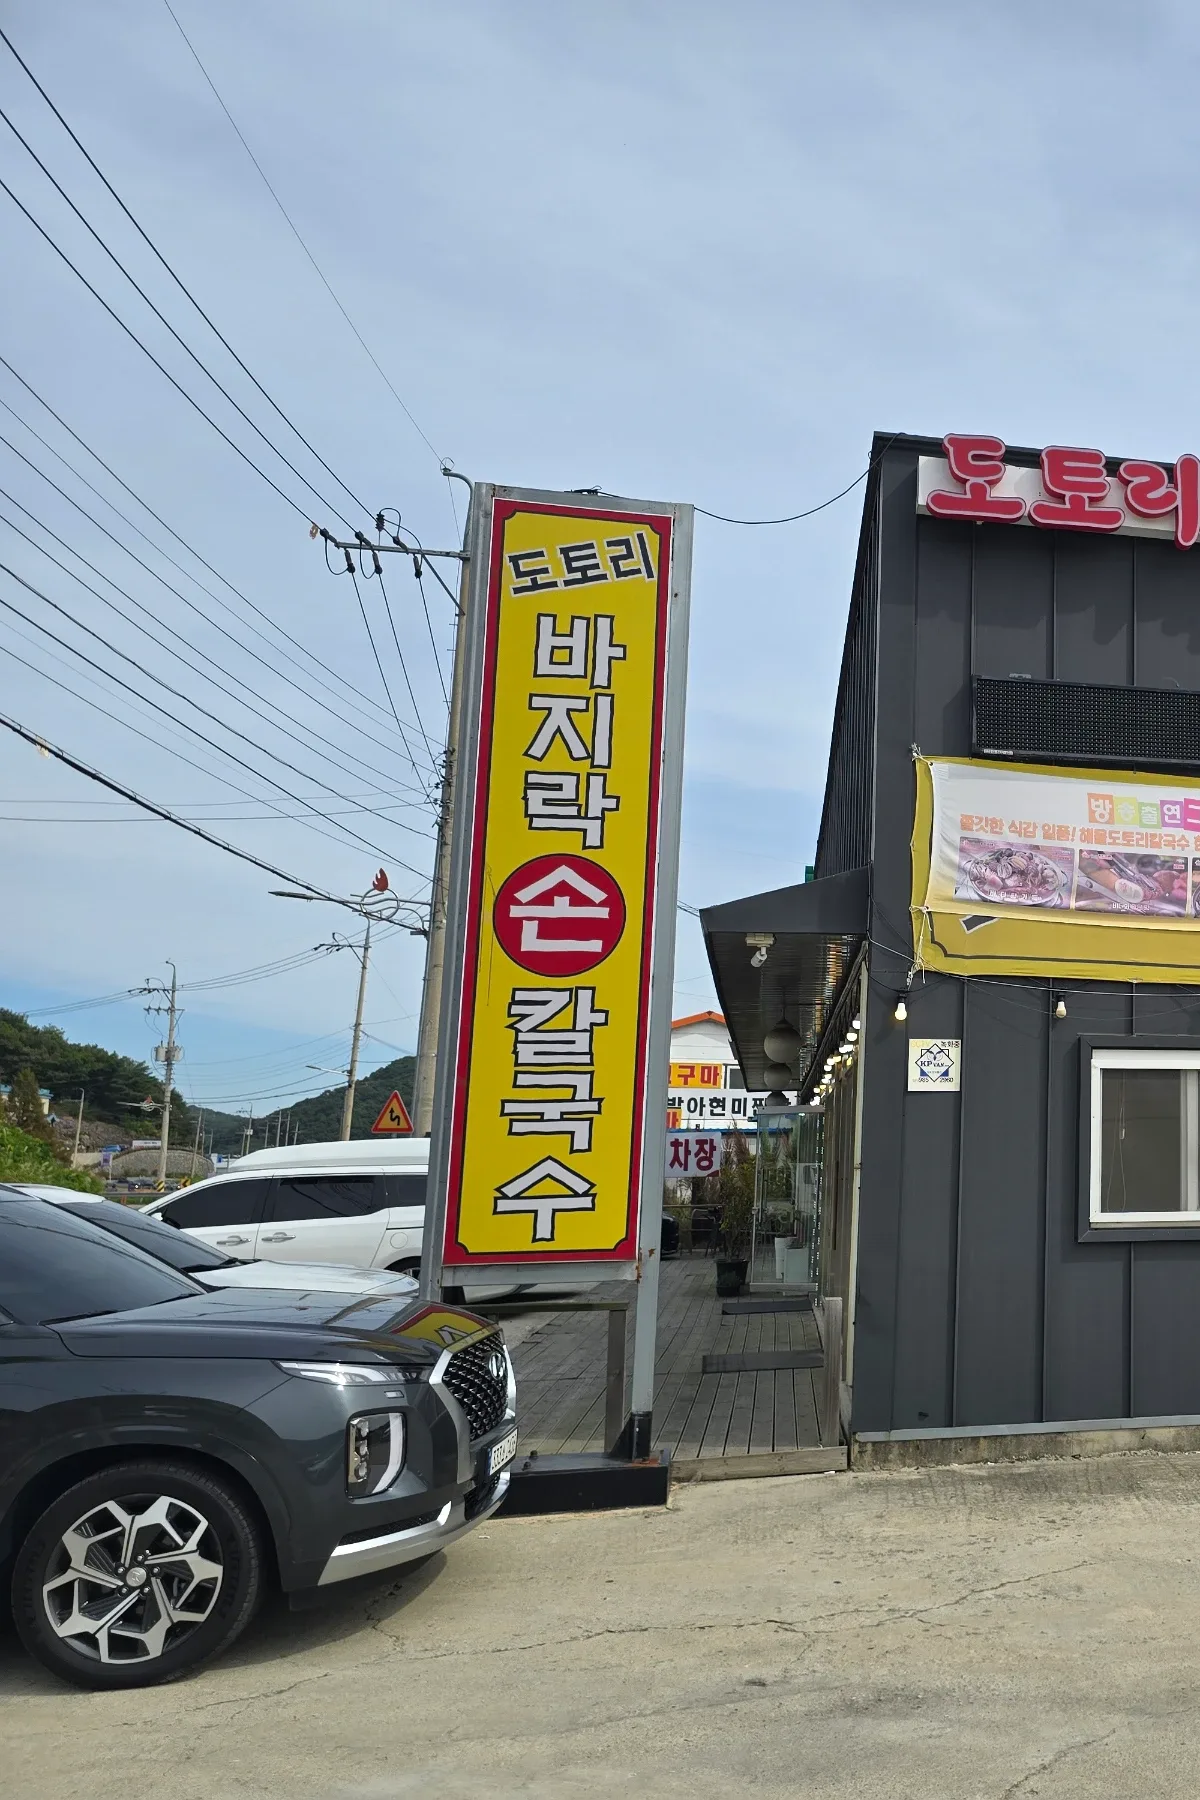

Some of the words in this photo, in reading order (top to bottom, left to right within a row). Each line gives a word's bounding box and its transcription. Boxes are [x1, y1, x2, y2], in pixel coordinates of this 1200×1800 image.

[505, 530, 657, 598] 도토리
[1008, 819, 1039, 840] 식감
[668, 1064, 720, 1087] 구마
